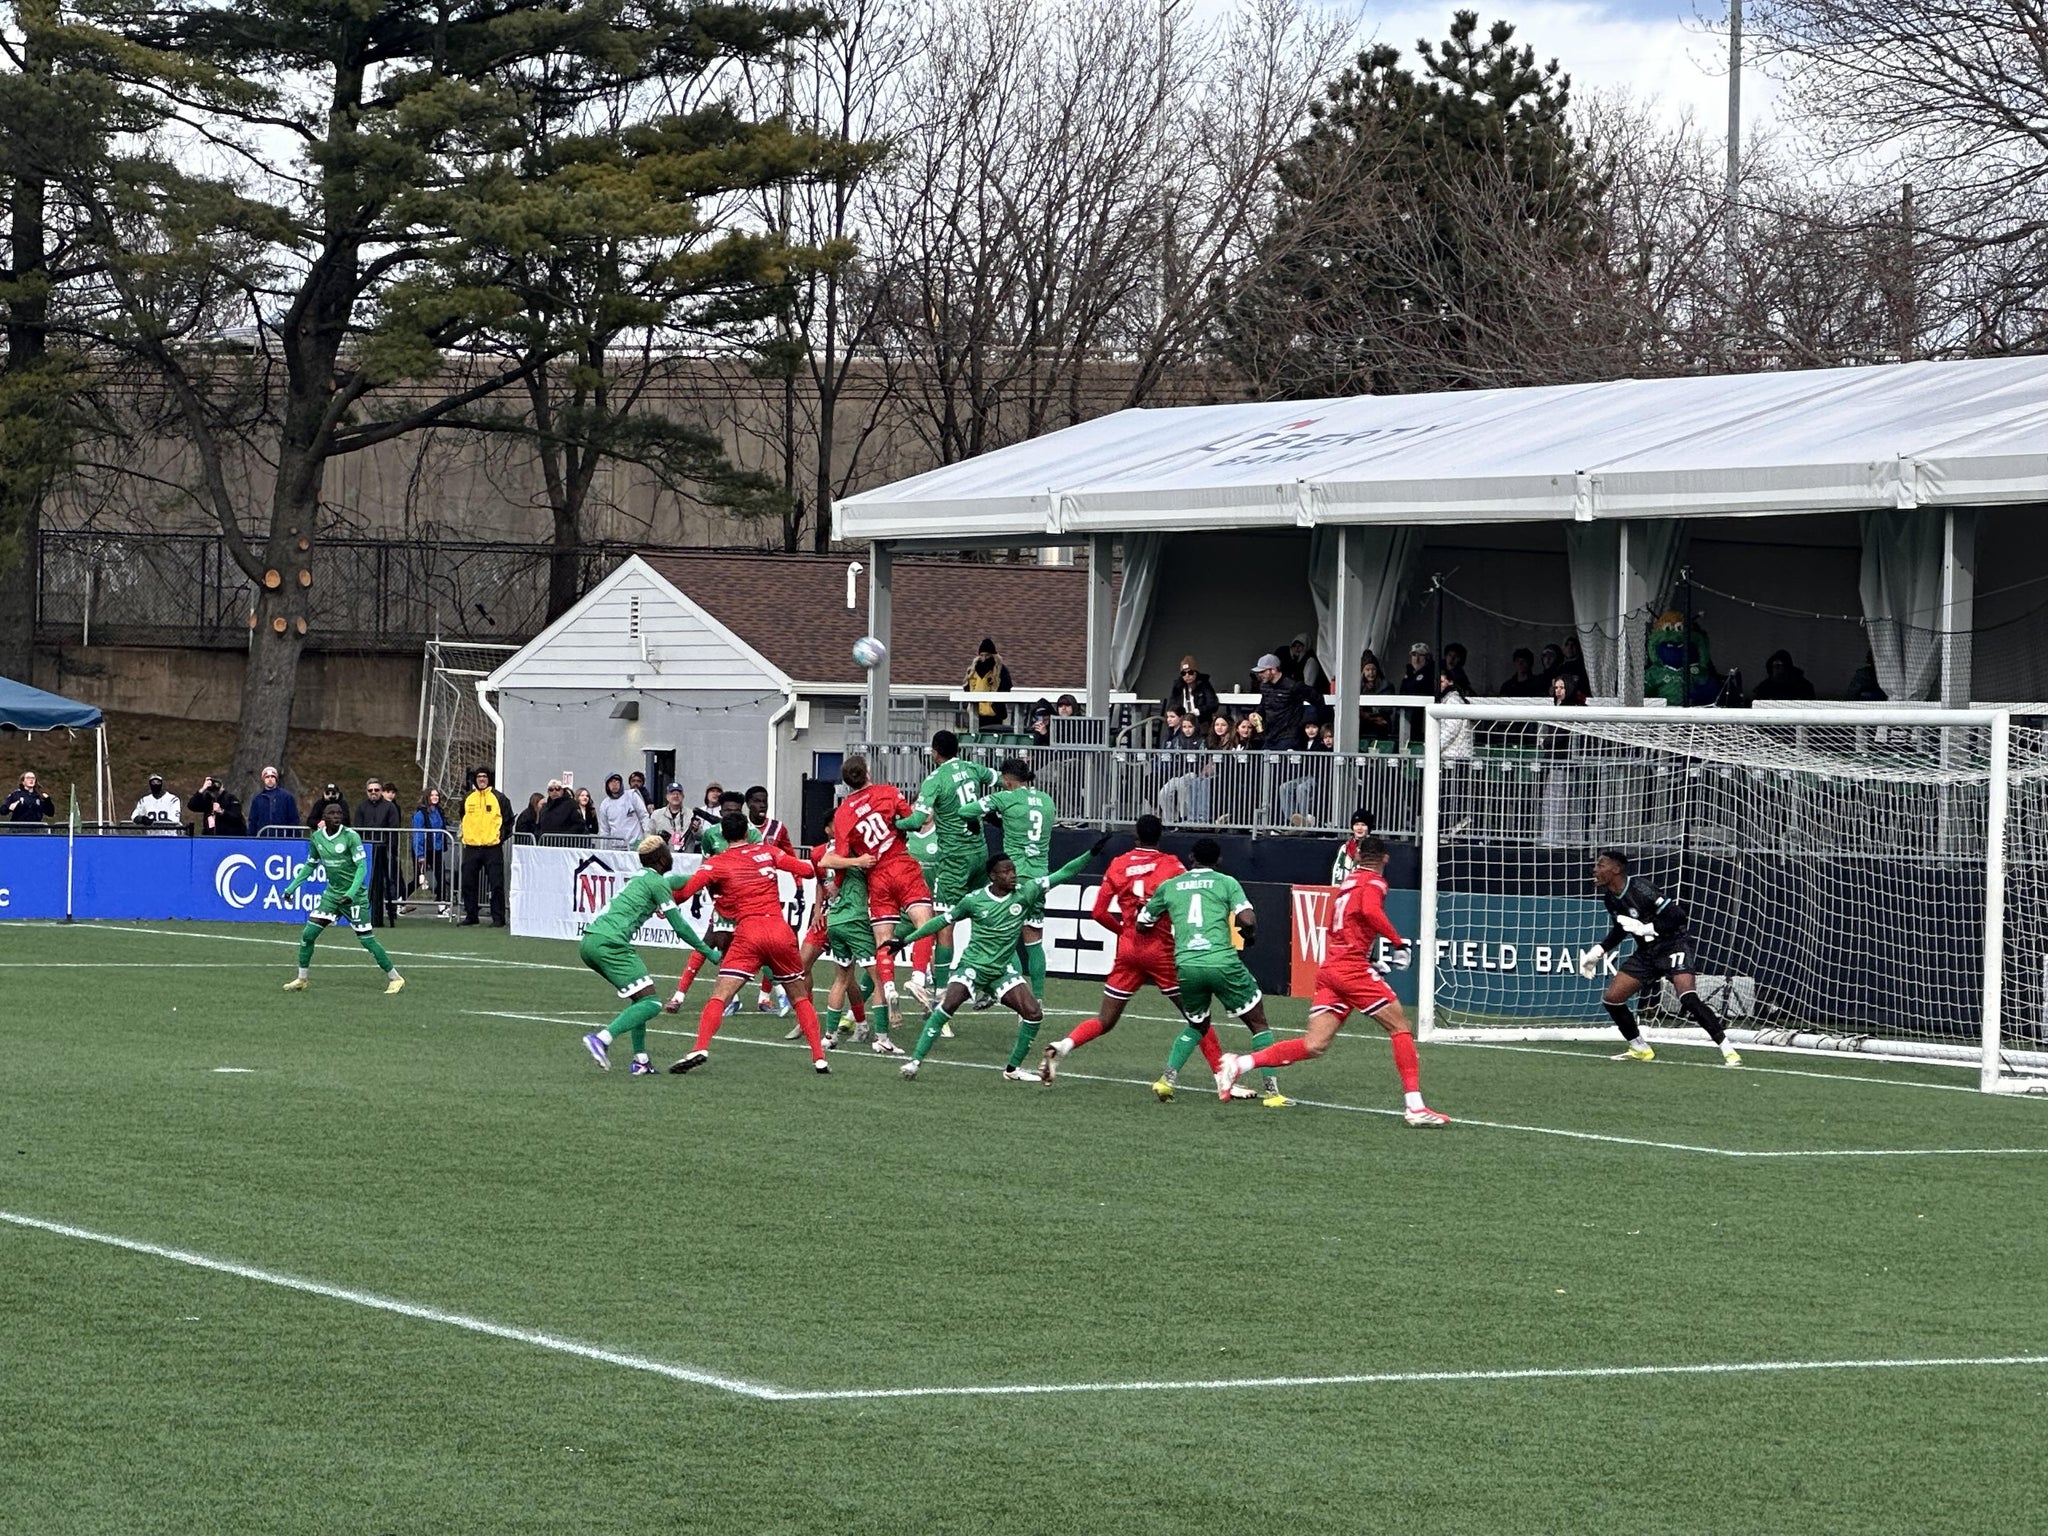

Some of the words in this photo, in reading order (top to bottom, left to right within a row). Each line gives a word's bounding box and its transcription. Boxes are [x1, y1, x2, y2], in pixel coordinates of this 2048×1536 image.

[855, 812, 891, 850] 20
[1027, 810, 1043, 841] 3
[1187, 893, 1204, 928] 4
[631, 927, 680, 944] OVEMENTS
